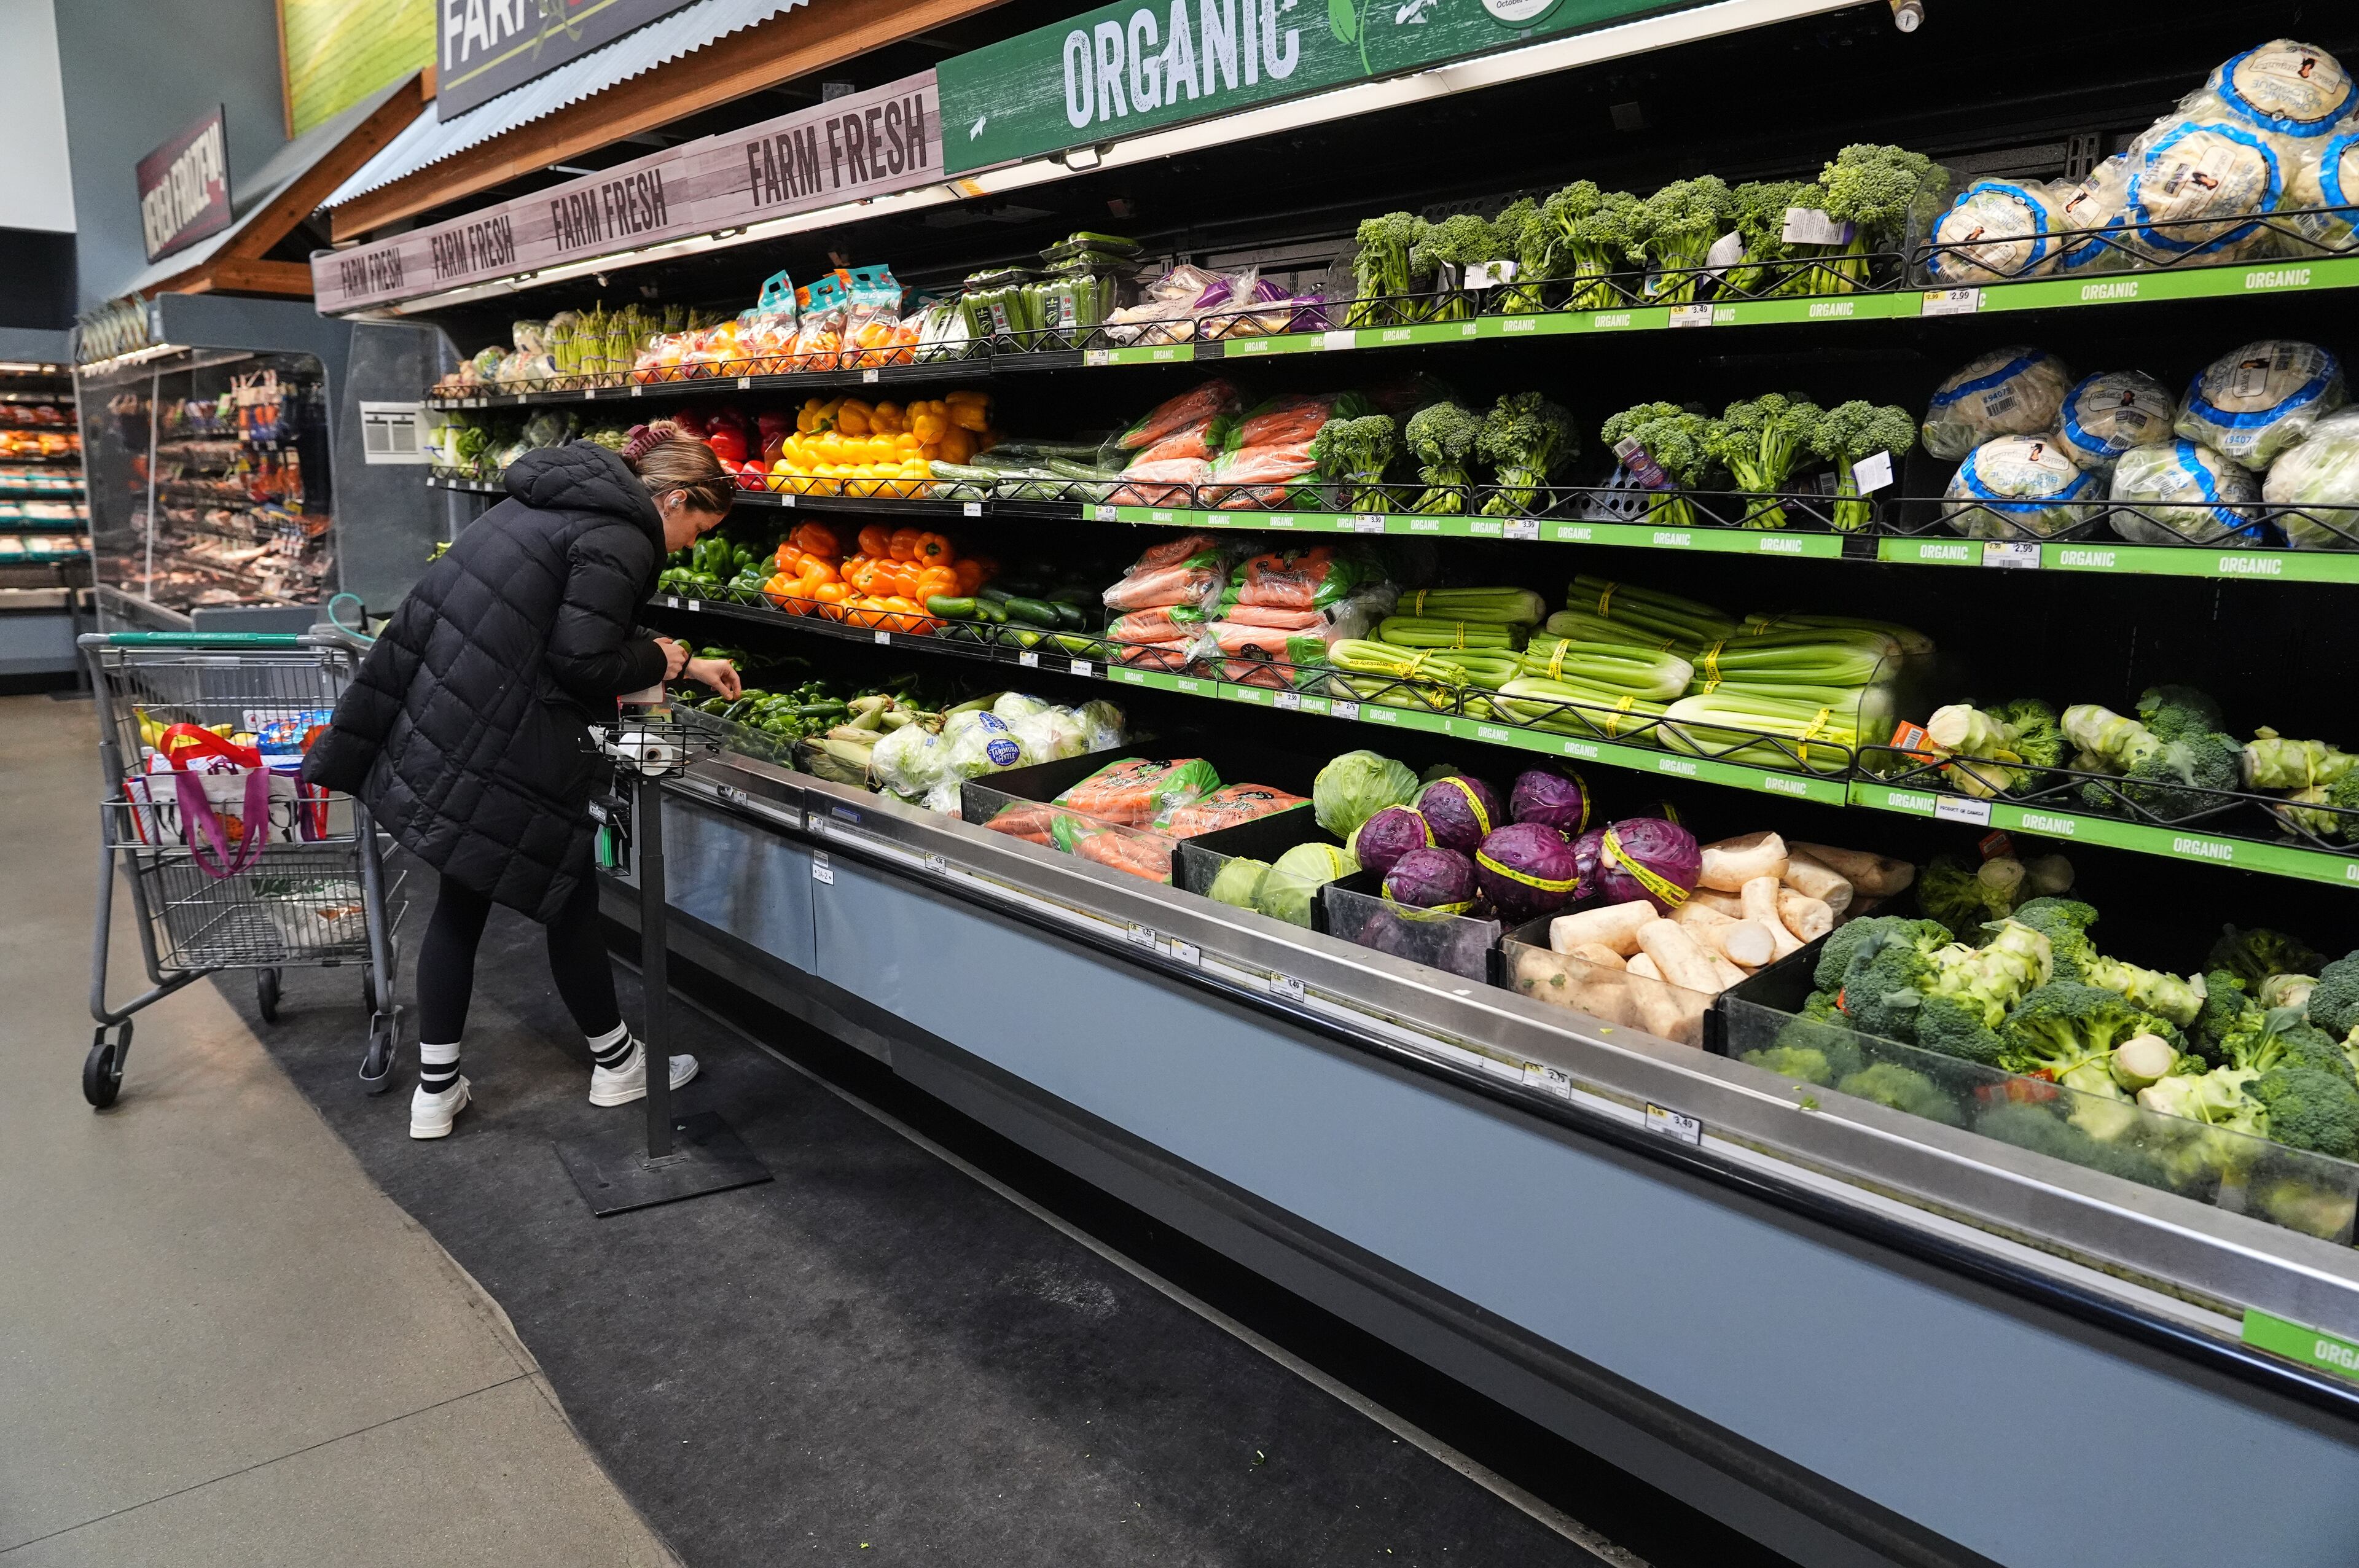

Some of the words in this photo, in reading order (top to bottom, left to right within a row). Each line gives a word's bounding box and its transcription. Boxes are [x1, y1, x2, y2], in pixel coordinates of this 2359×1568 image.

[1063, 0, 1299, 129] ORGANIC
[746, 125, 823, 206] FARM
[826, 93, 927, 188] FRESH
[550, 189, 601, 251] FARM
[601, 168, 667, 238] FRESH
[431, 230, 468, 279] FARM
[468, 215, 515, 271] FRESH
[369, 248, 404, 293] FRESH
[2245, 268, 2311, 289] ORGANIC
[2081, 281, 2138, 300] ORGANIC
[1713, 309, 1735, 322] ANIC
[1809, 302, 1853, 317] ORGANIC
[1503, 319, 1535, 332] ORGANIC
[1594, 314, 1630, 327] ORGANIC
[1311, 337, 1325, 347] ORGA
[1383, 329, 1410, 341] ORGANIC
[1245, 341, 1268, 352] ORGANIC
[1153, 349, 1174, 359] ORGANIC
[1152, 512, 1173, 522] ORGANIC
[1208, 515, 1230, 525] ORGANIC
[1270, 516, 1294, 526] ORGANIC
[1337, 518, 1355, 528] ORGA
[1410, 519, 1439, 531] ORGANIC
[1471, 521, 1501, 534] ORGANIC
[1557, 526, 1592, 540] ORGANIC
[1653, 532, 1691, 546] ORGANIC
[1760, 537, 1802, 553] ORGANIC
[1920, 544, 1969, 560] ORGANIC
[2060, 550, 2116, 567] ORGANIC
[2219, 556, 2282, 575] ORGANIC
[1124, 671, 1144, 683] ORGANIC
[1178, 680, 1198, 691] ORGANIC
[1237, 688, 1260, 700] ORGANIC
[1302, 698, 1325, 711] ORGANIC
[1369, 708, 1396, 722] ORGANIC
[1478, 726, 1509, 742] ORGANIC
[988, 746, 1019, 759] TANIMURA
[1564, 742, 1598, 758] ORGANIC
[997, 752, 1015, 764] ANTLE
[1659, 759, 1696, 776] ORGANIC
[1765, 777, 1807, 795] ORGANIC
[1888, 792, 1935, 812] ORGANIC
[2022, 813, 2075, 835] ORGANIC
[2173, 837, 2233, 860] ORGANIC
[1624, 857, 1639, 872] Grown
[1516, 873, 1530, 882] rown
[1639, 869, 1664, 889] Organically
